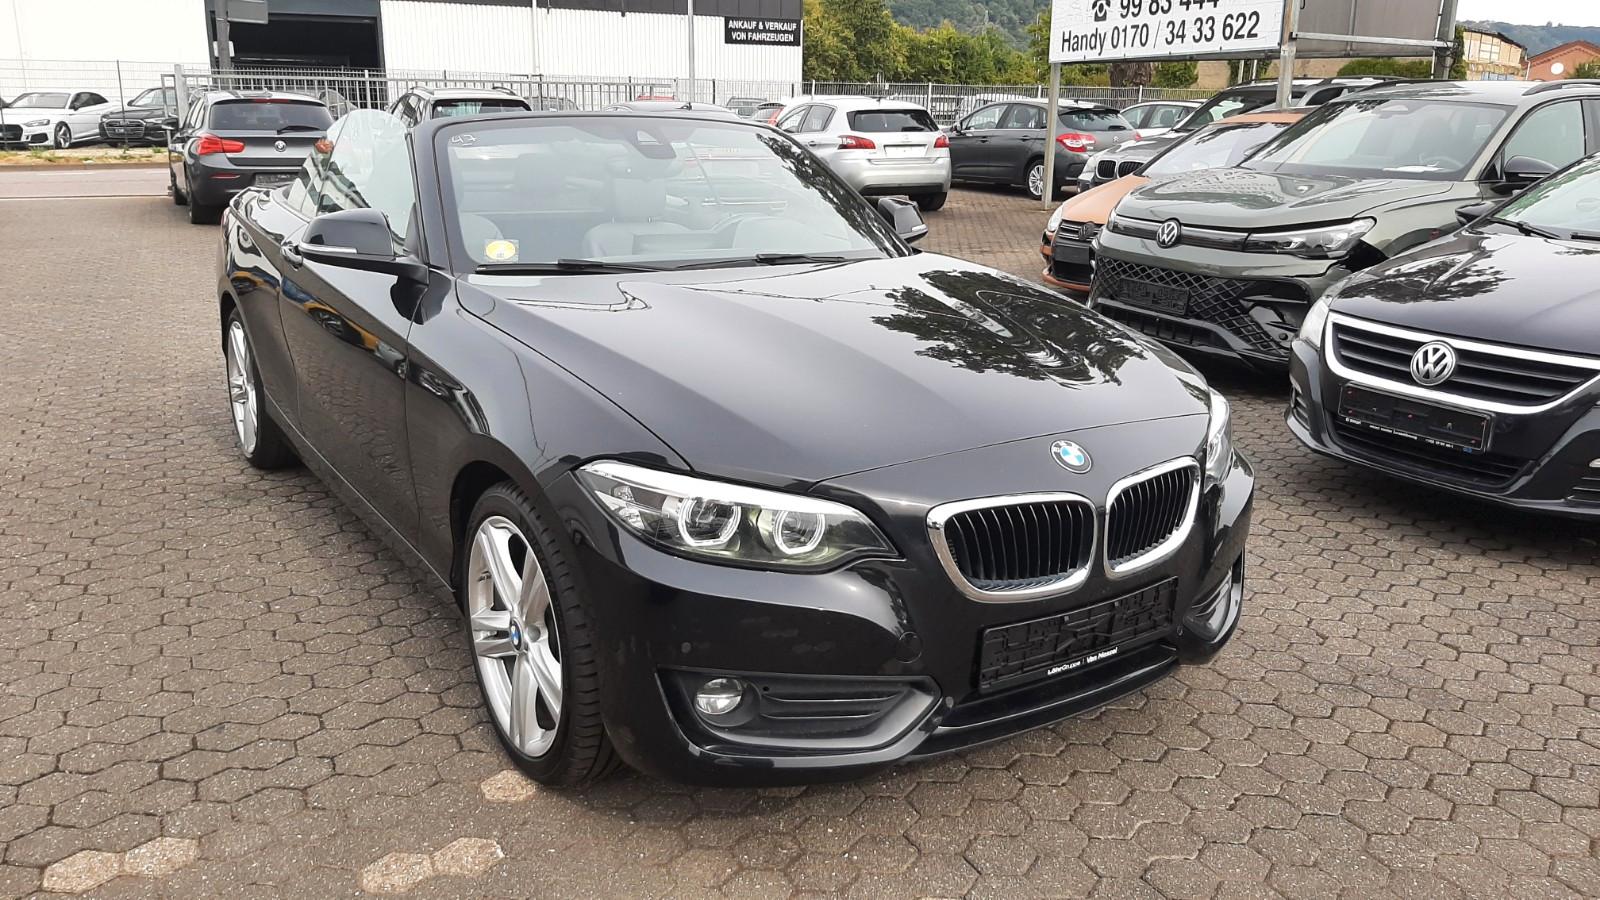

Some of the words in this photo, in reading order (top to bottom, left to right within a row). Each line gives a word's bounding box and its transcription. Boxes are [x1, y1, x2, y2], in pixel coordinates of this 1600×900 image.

[1120, 0, 1141, 18] 99
[728, 20, 757, 29] ANKAUF
[758, 21, 763, 30] &
[765, 21, 797, 31] VERKAUF
[1061, 27, 1107, 56] Handy
[1111, 23, 1149, 48] 0170
[1153, 20, 1161, 49] /
[1165, 19, 1187, 45] 34
[1192, 15, 1216, 43] 33
[1222, 10, 1260, 41] 622
[732, 32, 747, 40] VON
[748, 32, 794, 42] FAHRZEUGEN
[1158, 220, 1178, 246] VW
[1413, 342, 1453, 384] VW
